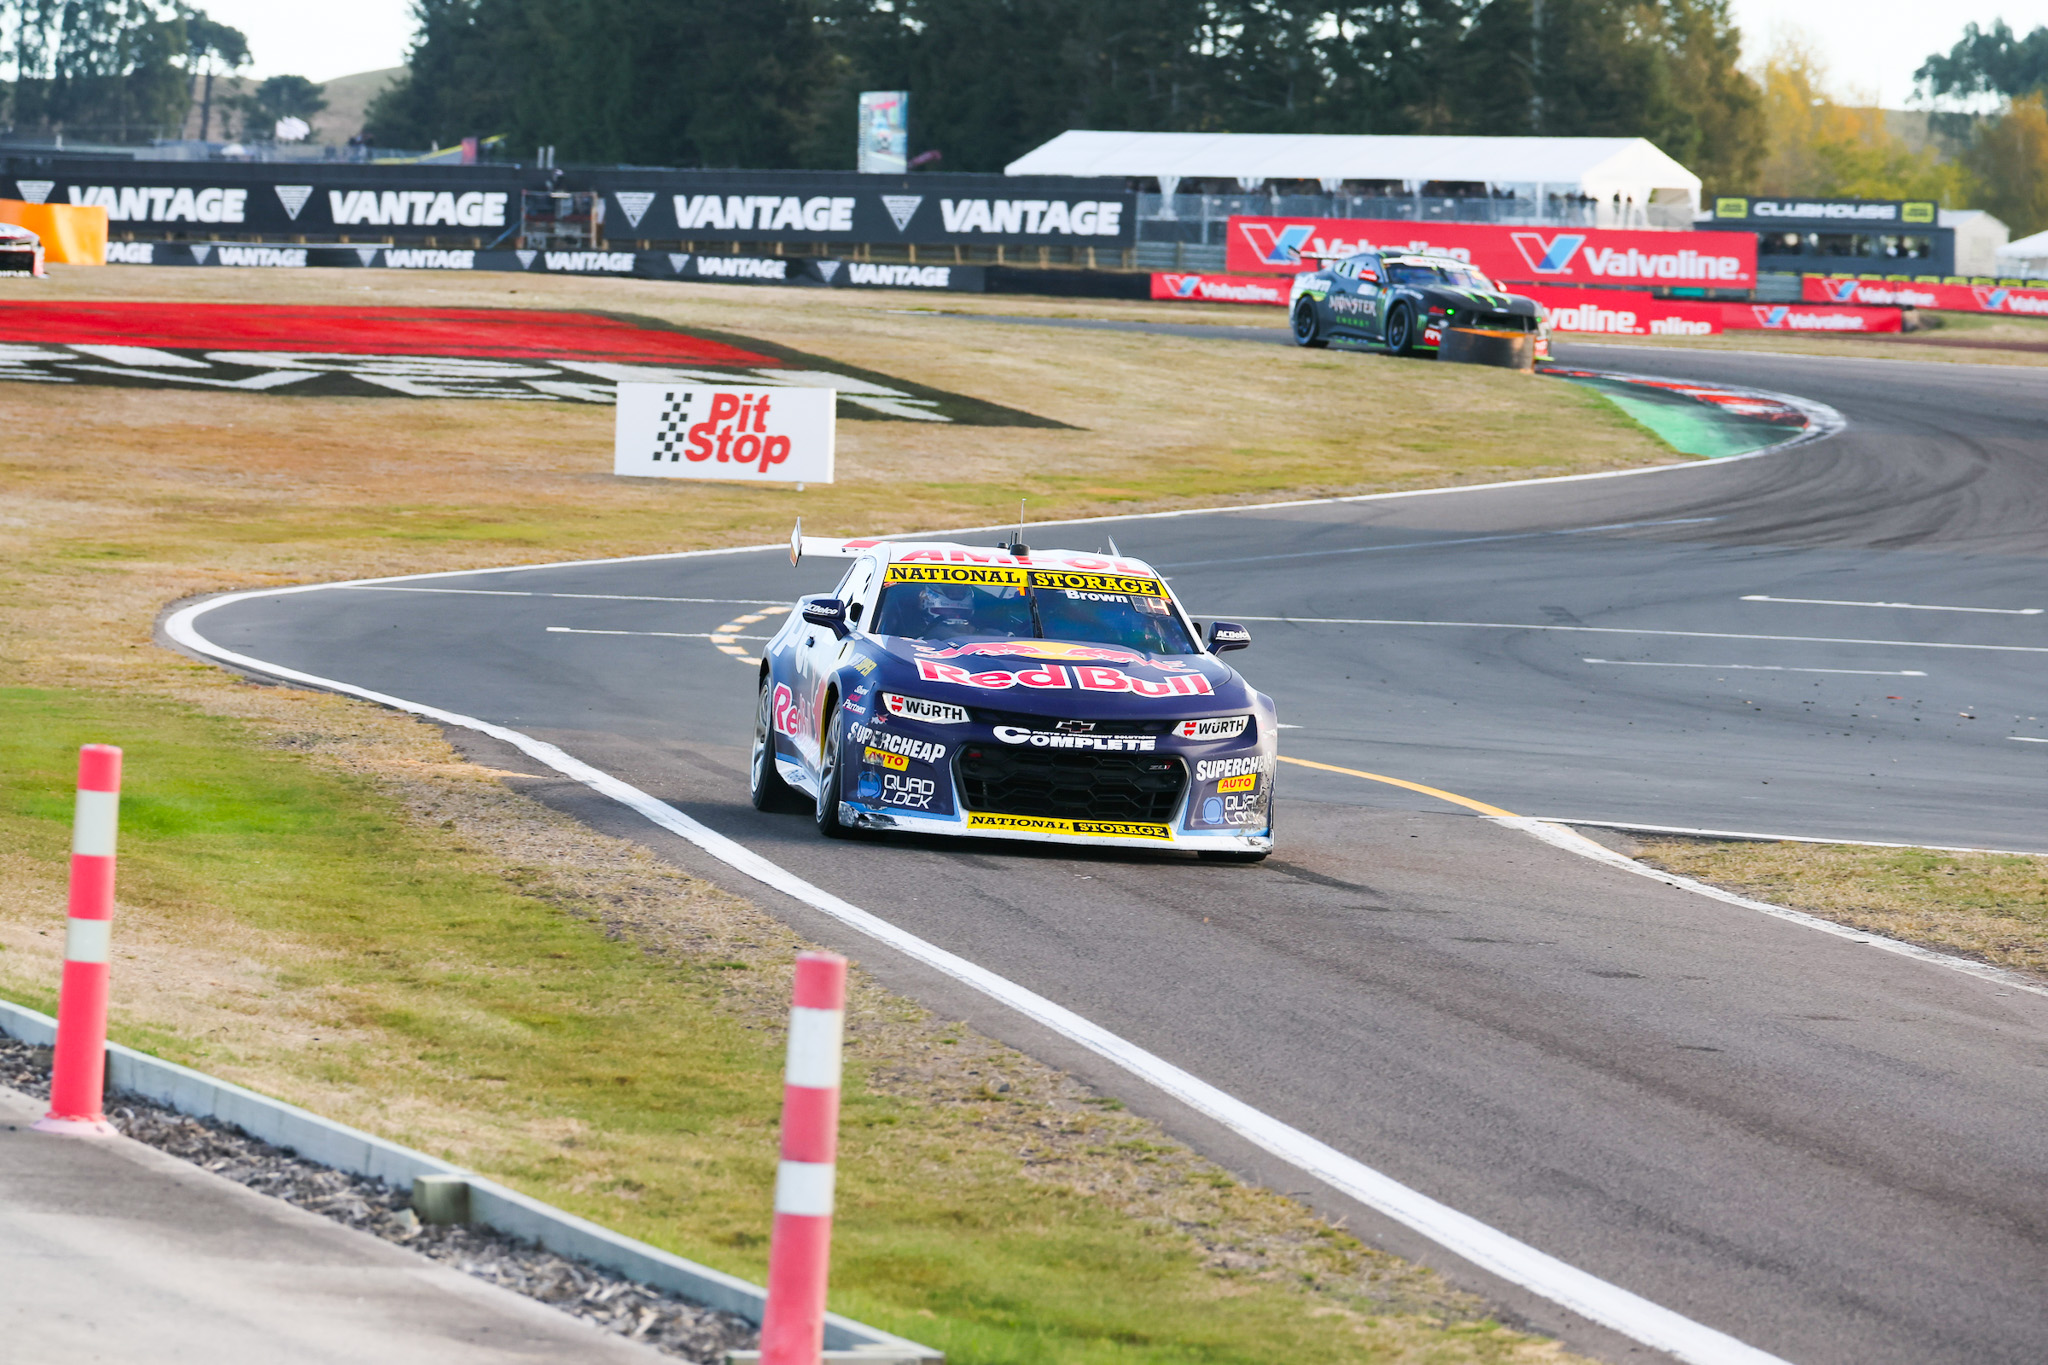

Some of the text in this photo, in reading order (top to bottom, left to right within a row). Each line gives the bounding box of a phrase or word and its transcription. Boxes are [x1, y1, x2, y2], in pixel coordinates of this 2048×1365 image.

[68, 185, 248, 223] VANTAGE
[329, 190, 508, 227] VANTAGE
[673, 194, 856, 231] VANTAGE
[1753, 201, 1897, 219] CLUBHOUSE
[940, 199, 1123, 235] VANTAGE
[218, 247, 308, 268] VANTAGE
[384, 249, 475, 269] VANTAGE
[544, 252, 636, 272] VANTAGE
[697, 256, 787, 280] VANTAGE
[1583, 247, 1740, 280] Valvoline
[849, 263, 951, 287] VANTAGE
[1200, 281, 1279, 301] Valvoline
[1857, 287, 1935, 307] Valvoline
[1328, 295, 1377, 316] MONSTER
[1787, 313, 1864, 330] Valvoline
[708, 393, 771, 435] Pit
[684, 424, 791, 473] Stop
[890, 566, 1157, 595] NATIONAL STORAGE
[1066, 589, 1129, 604] Brown
[914, 658, 1072, 690] Red
[1072, 664, 1215, 698] Bull
[906, 700, 963, 721] WÜRTH
[1199, 720, 1244, 734] WÜRTH
[993, 726, 1156, 750] COMPLETE
[884, 774, 935, 796] QUAD
[1222, 778, 1252, 788] AUTO
[880, 789, 933, 809] LOCK
[971, 816, 1167, 837] NATIONAL STORAGE
